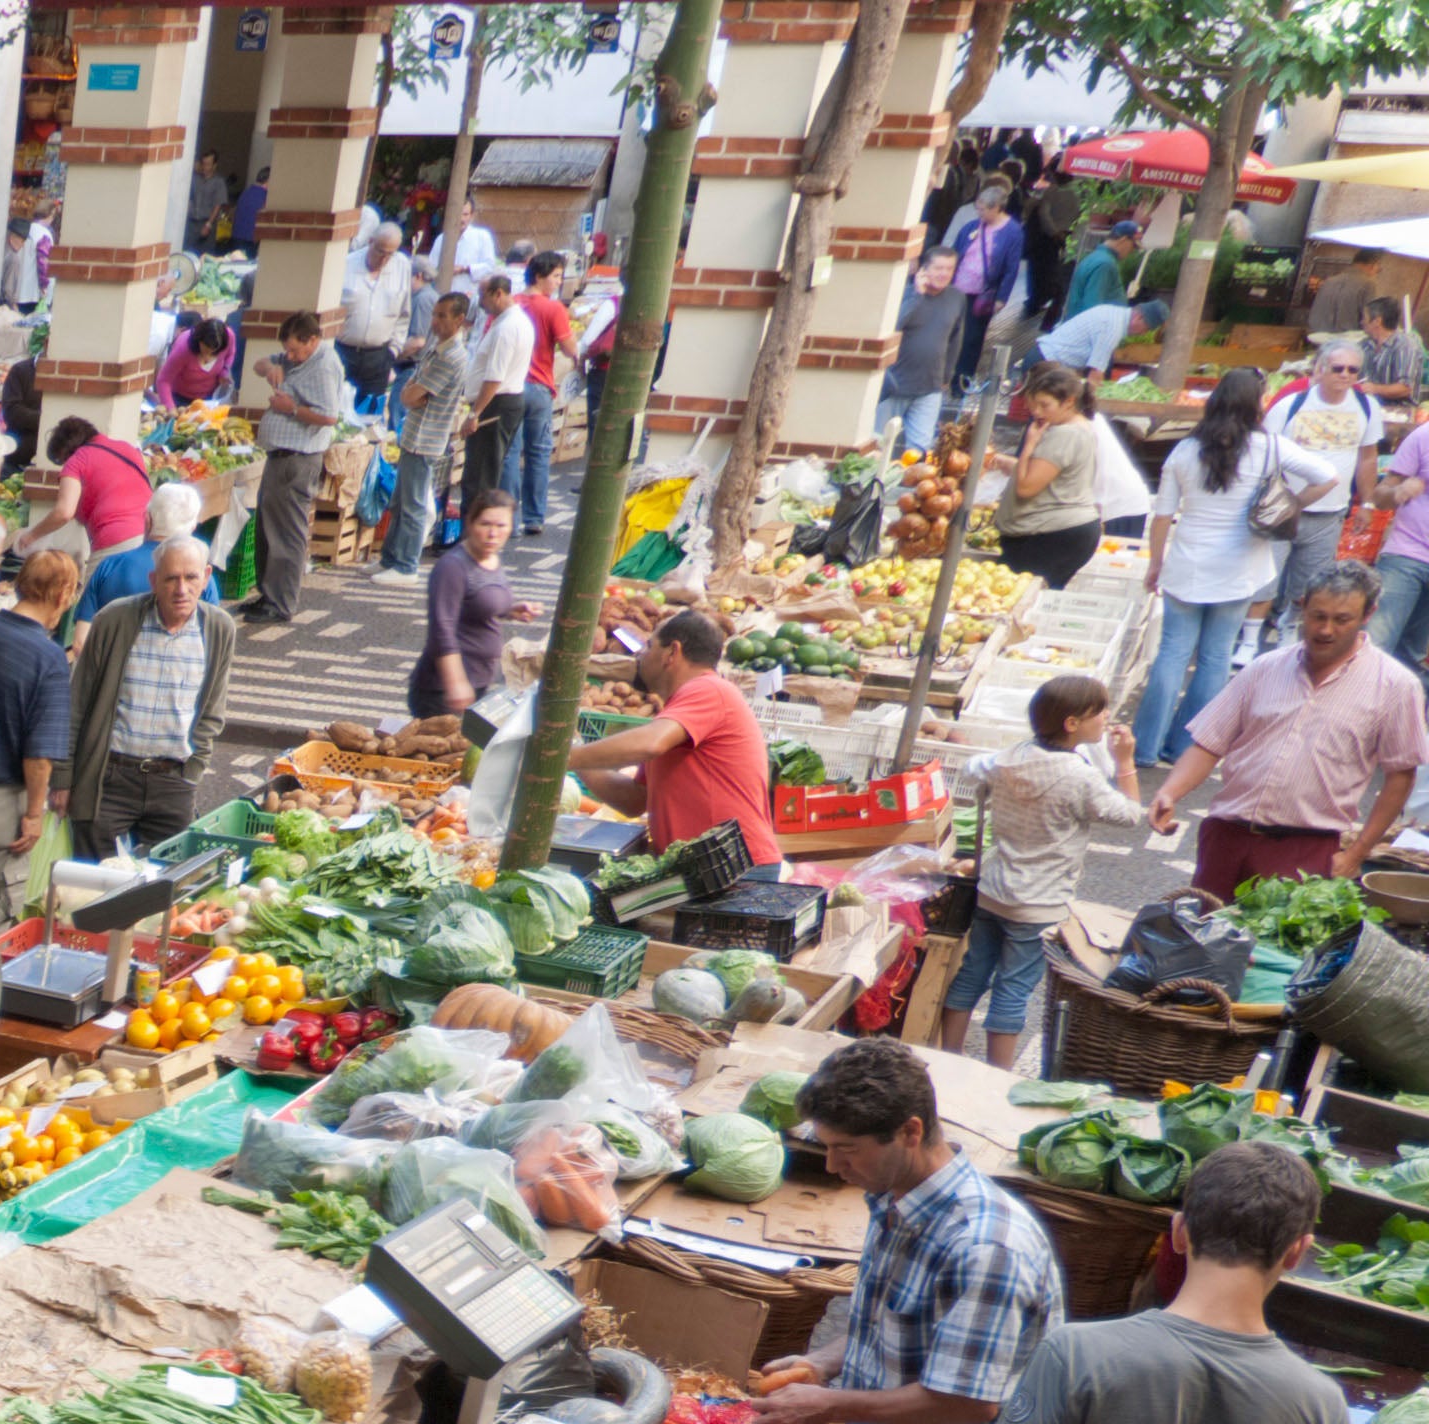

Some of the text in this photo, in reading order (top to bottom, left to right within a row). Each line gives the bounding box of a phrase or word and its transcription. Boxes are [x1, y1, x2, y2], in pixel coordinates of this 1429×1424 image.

[1070, 157, 1118, 173] AMSTEL BEER
[1140, 168, 1180, 182] AMSTEL
